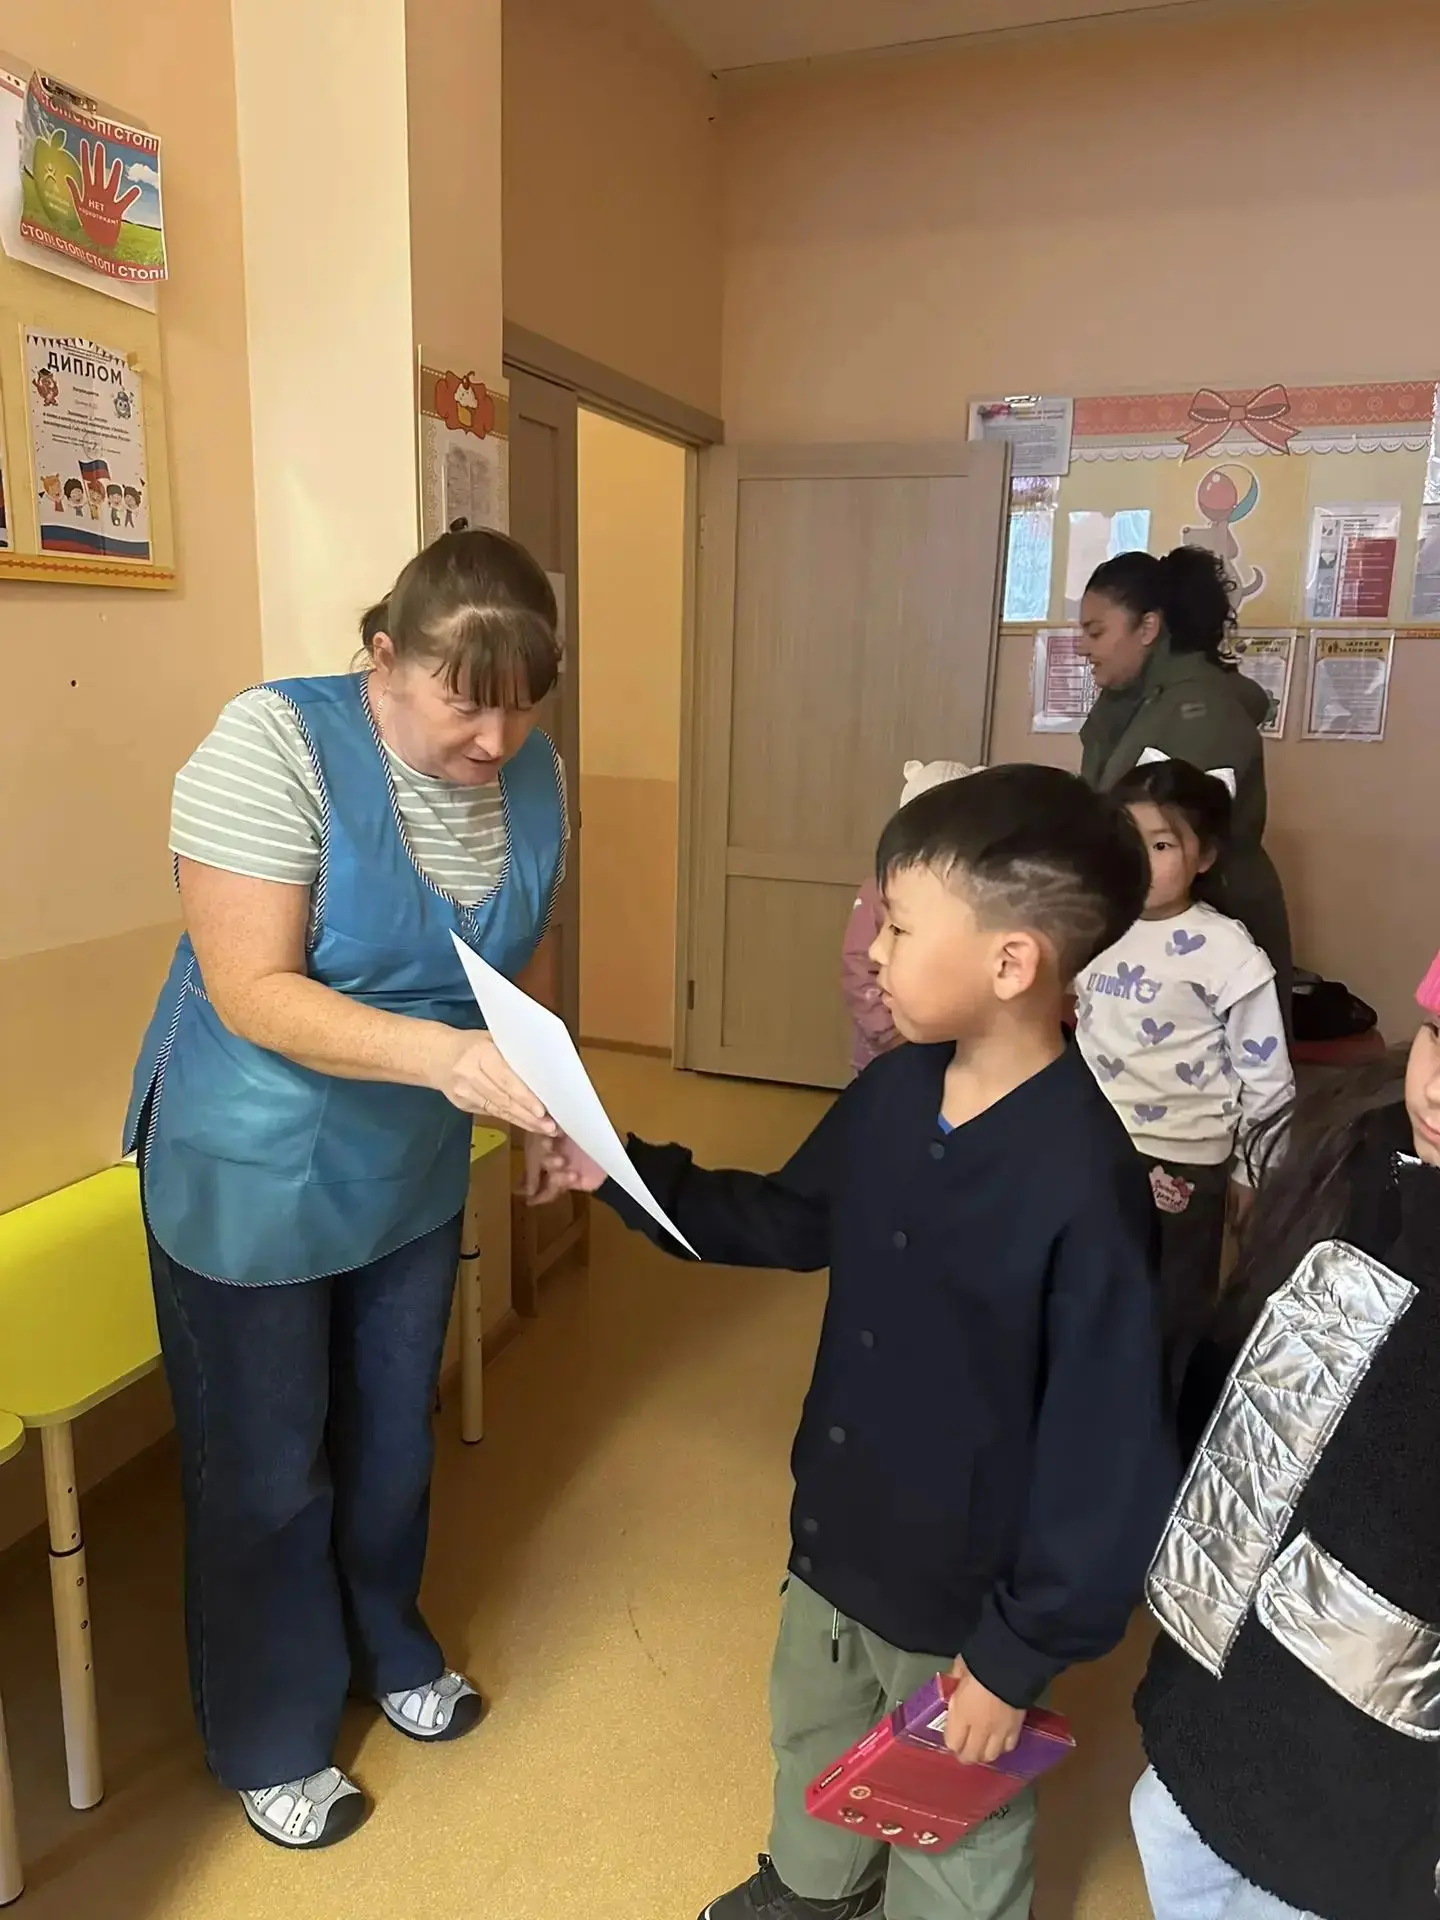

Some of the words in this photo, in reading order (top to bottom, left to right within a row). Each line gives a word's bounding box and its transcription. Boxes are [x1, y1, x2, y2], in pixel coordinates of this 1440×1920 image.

[88, 199, 105, 212] НЕТ
[21, 222, 55, 244] СТОП!
[55, 238, 86, 260] СТОП!
[86, 252, 116, 274] СТОП!
[118, 265, 164, 280] СТОП!
[47, 351, 122, 386] ДИПЛОМ
